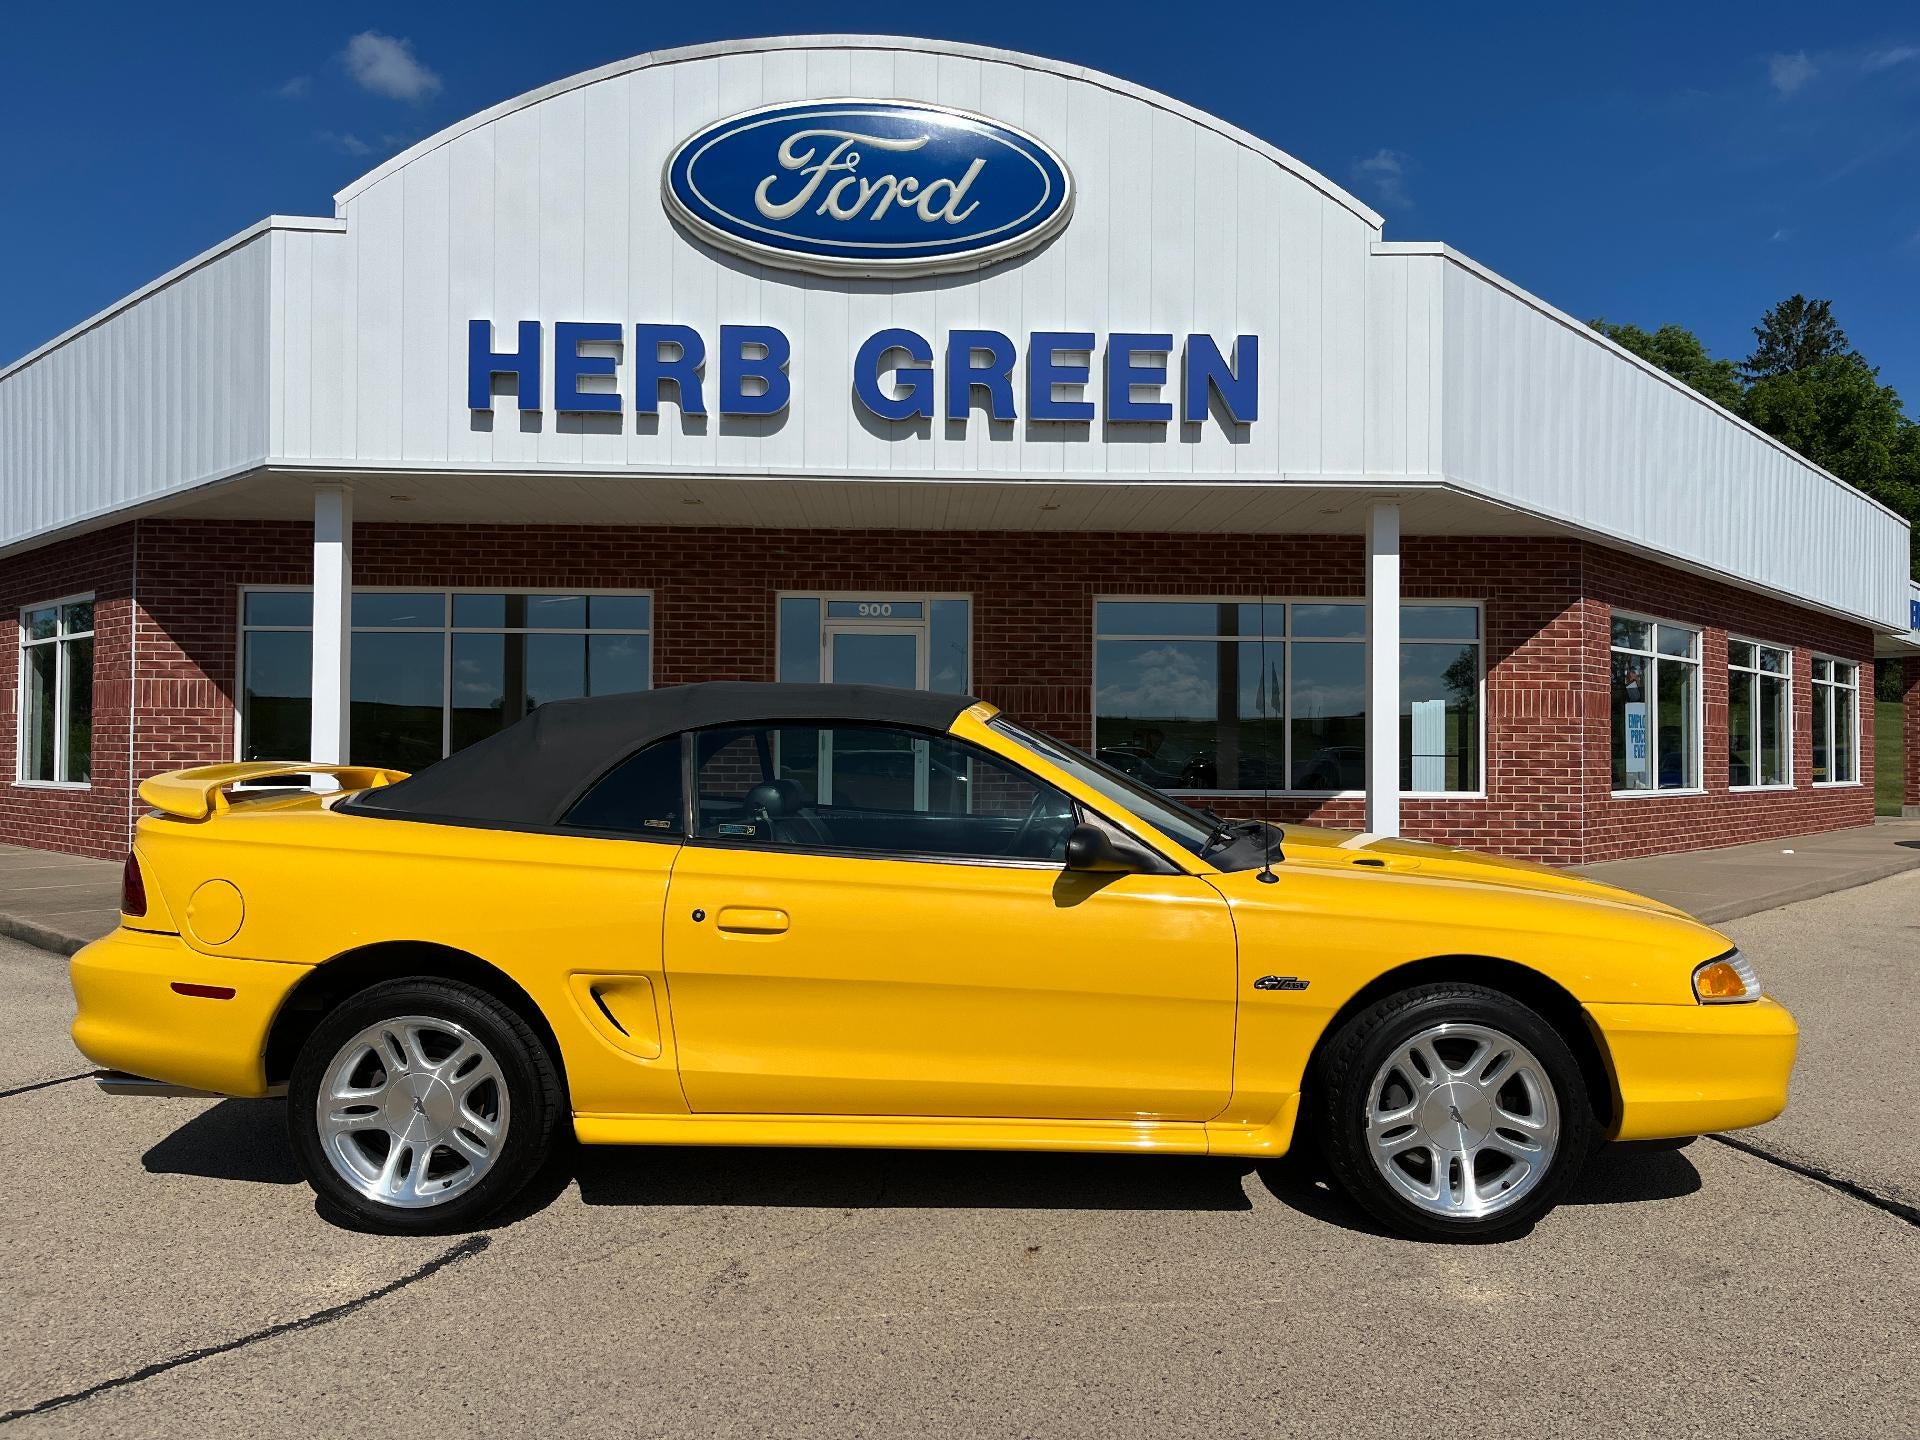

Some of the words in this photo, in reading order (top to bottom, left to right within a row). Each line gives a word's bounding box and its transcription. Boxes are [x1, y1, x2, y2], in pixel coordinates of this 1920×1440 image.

[754, 129, 987, 225] Ford
[468, 319, 791, 417] HERB
[853, 327, 1260, 425] GREEN
[858, 603, 893, 617] 900
